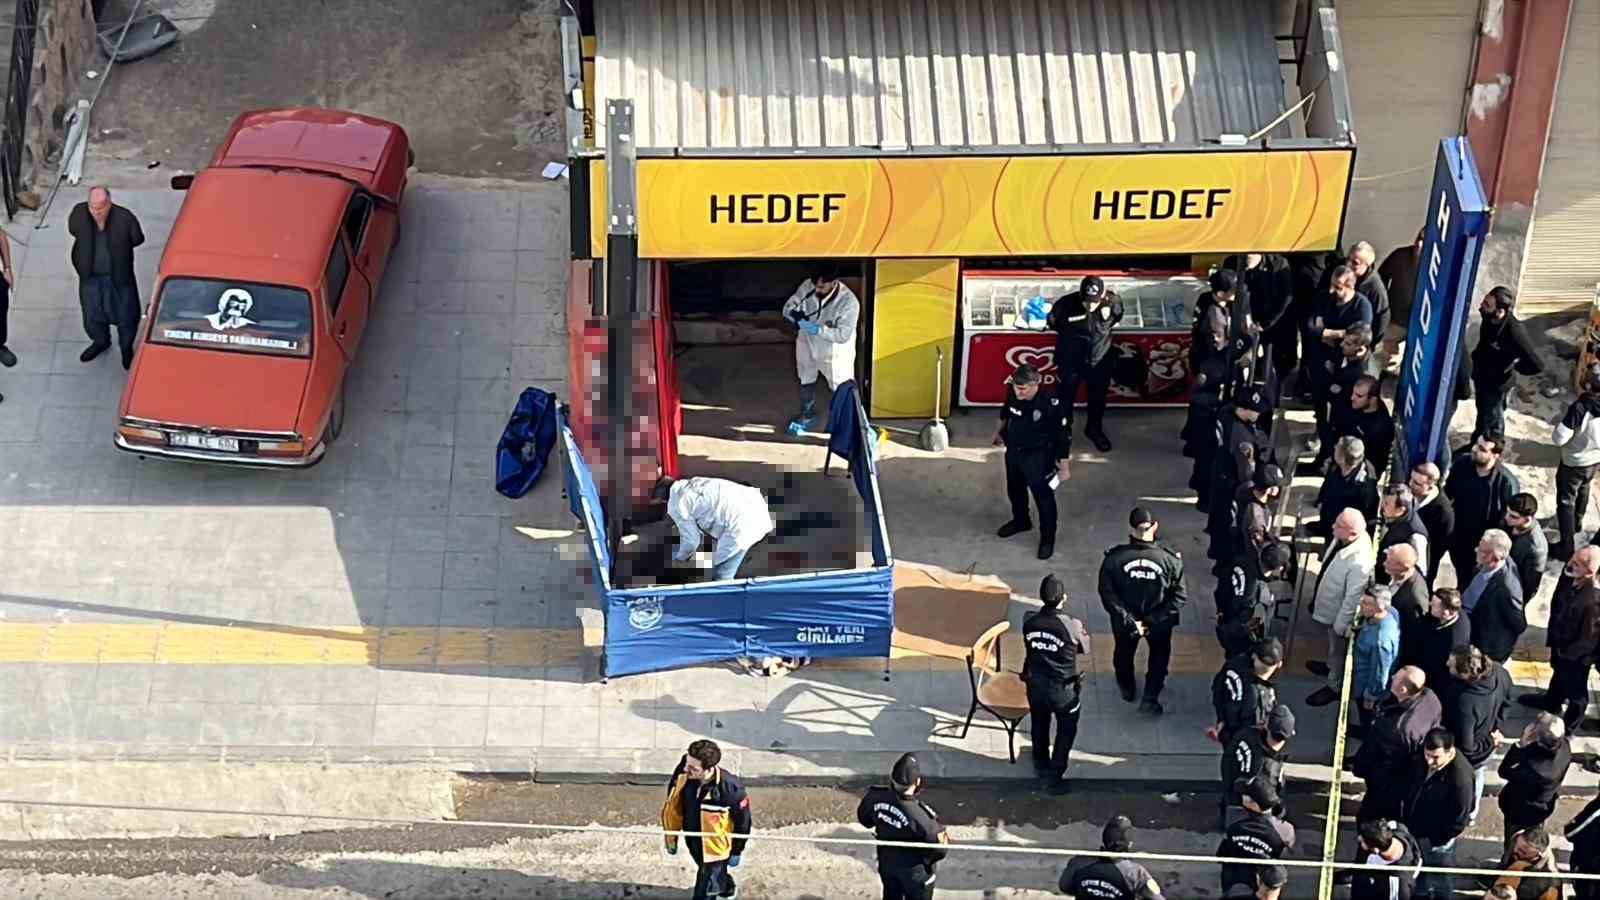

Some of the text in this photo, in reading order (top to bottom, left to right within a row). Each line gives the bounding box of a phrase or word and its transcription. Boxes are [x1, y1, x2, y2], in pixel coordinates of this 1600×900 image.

[709, 192, 847, 224] HEDEF
[1092, 188, 1232, 220] HEDEF
[1404, 190, 1450, 418] HEDEF
